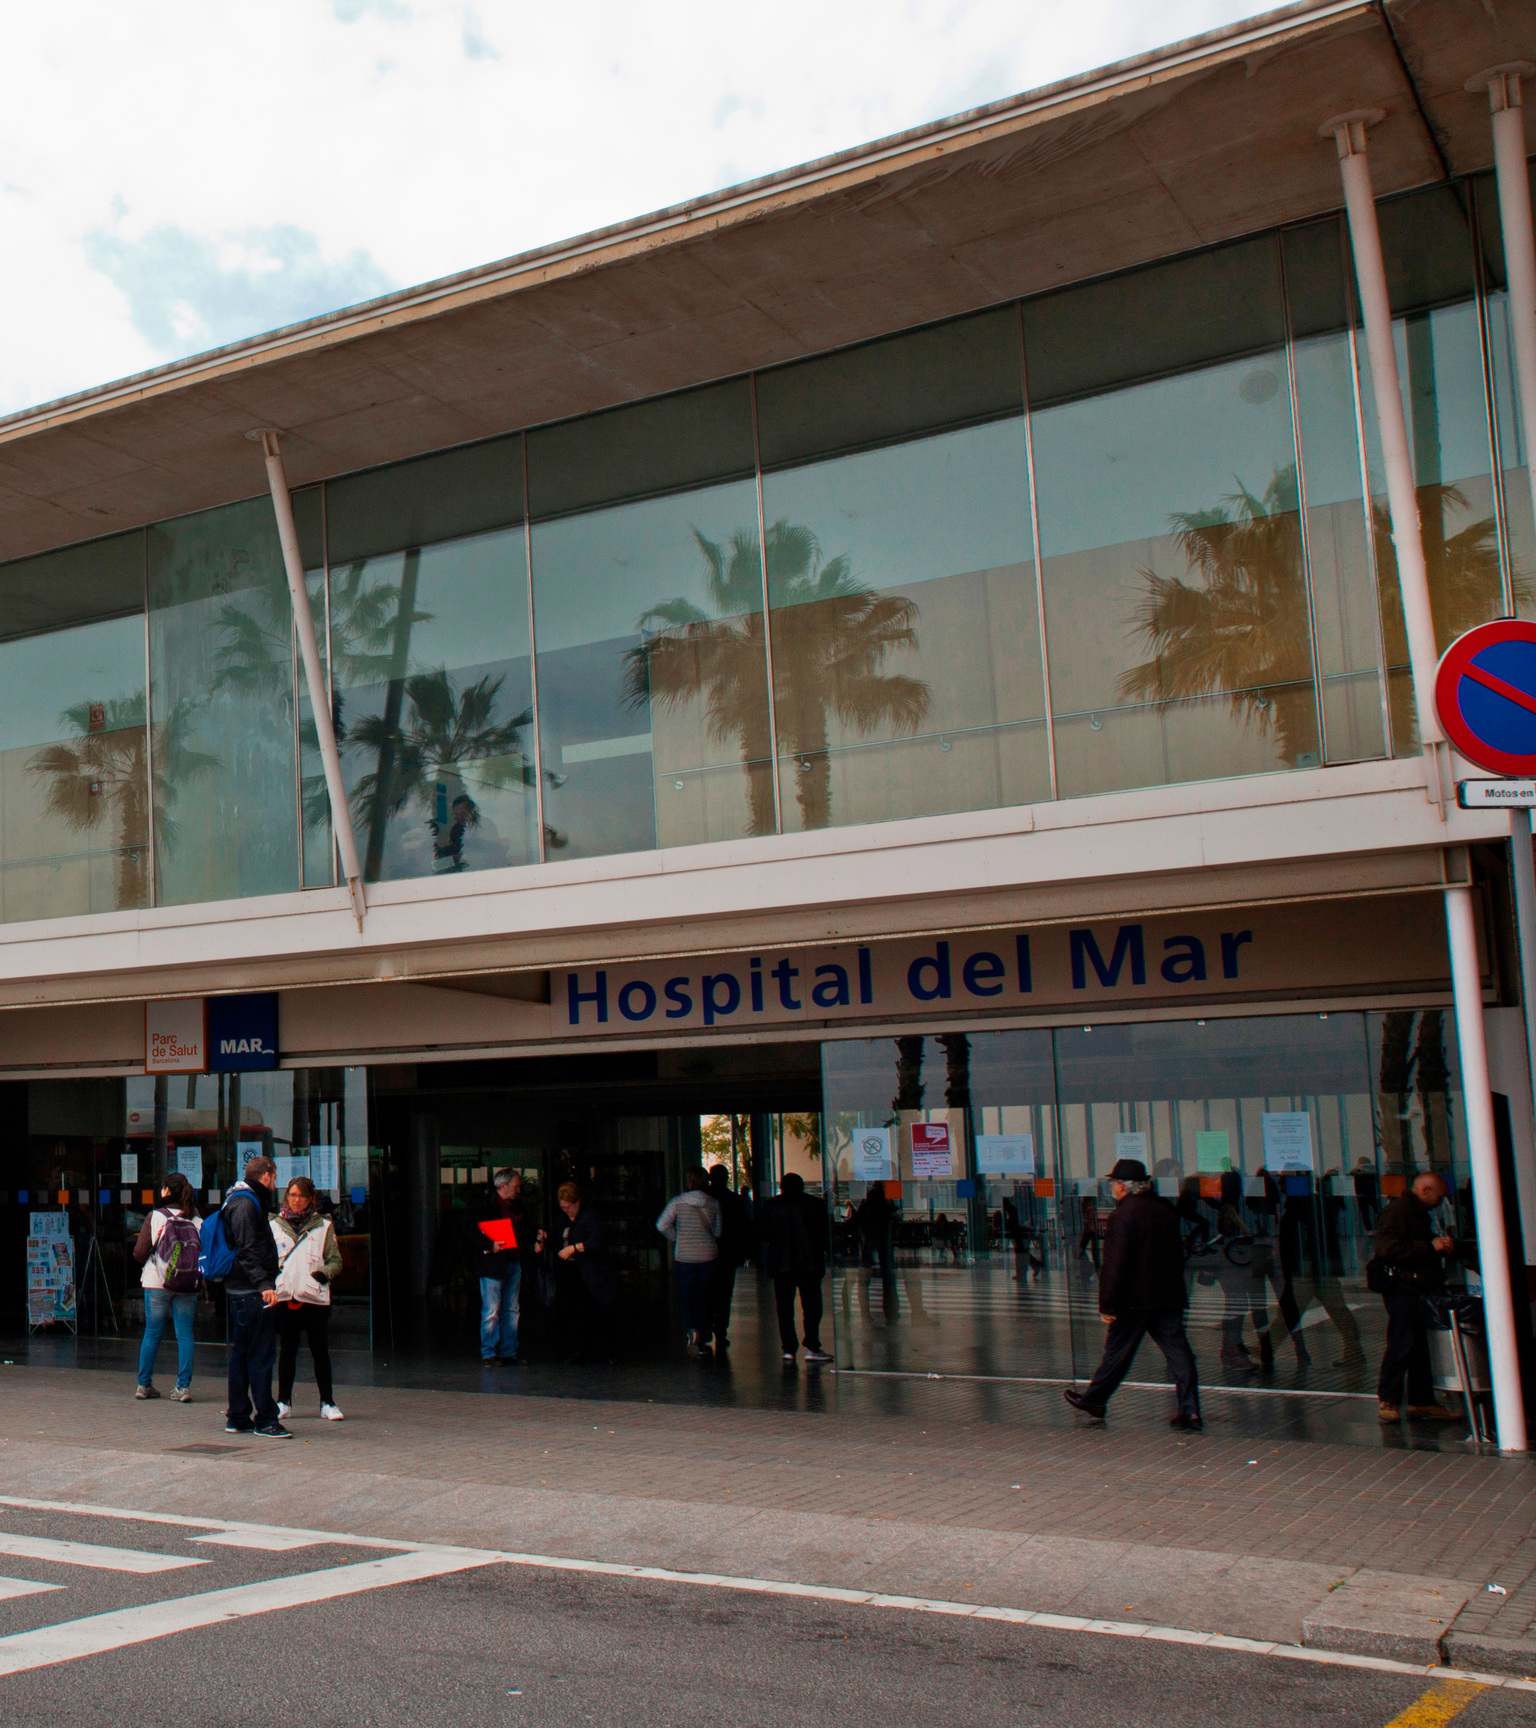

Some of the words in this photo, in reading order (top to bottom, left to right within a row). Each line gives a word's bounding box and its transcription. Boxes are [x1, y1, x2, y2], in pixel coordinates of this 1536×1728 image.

[1484, 788, 1517, 798] Motos
[1519, 790, 1534, 798] en
[567, 948, 873, 1025] Hospital
[906, 933, 1032, 1001] del
[1069, 924, 1253, 990] Mar
[152, 1033, 177, 1044] Parc
[152, 1046, 166, 1057] de
[169, 1044, 197, 1057] Salut
[220, 1038, 263, 1054] MAR
